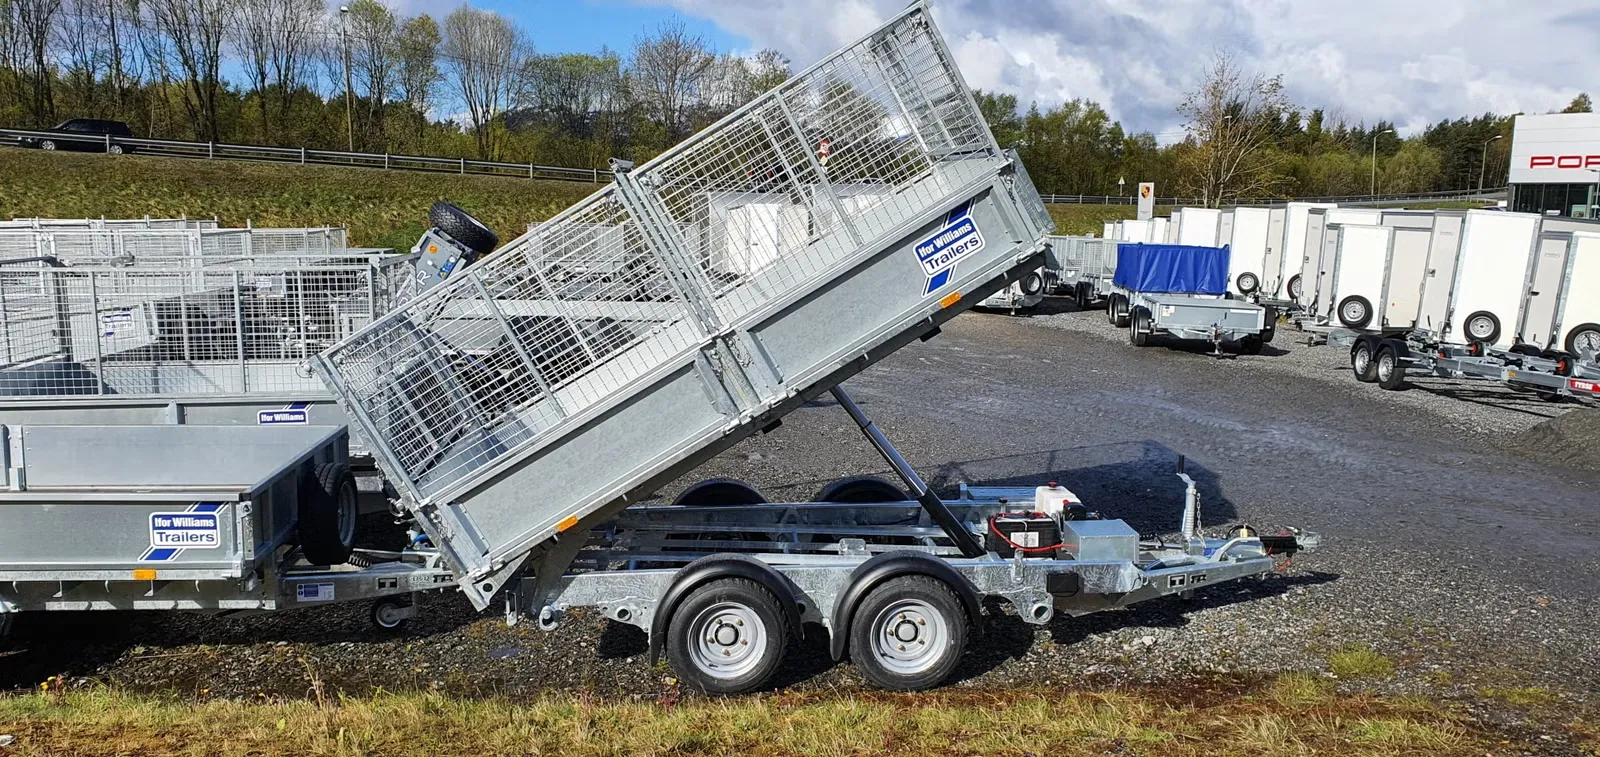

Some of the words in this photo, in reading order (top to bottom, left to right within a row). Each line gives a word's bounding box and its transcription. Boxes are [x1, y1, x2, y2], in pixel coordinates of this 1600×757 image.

[918, 243, 936, 258] Ifor
[933, 223, 972, 248] Williams
[925, 236, 979, 269] Trailers
[260, 414, 273, 422] Ifor
[273, 413, 304, 421] Williams
[154, 517, 172, 527] Ifor
[172, 517, 215, 527] Williams
[156, 532, 215, 542] Trailers
